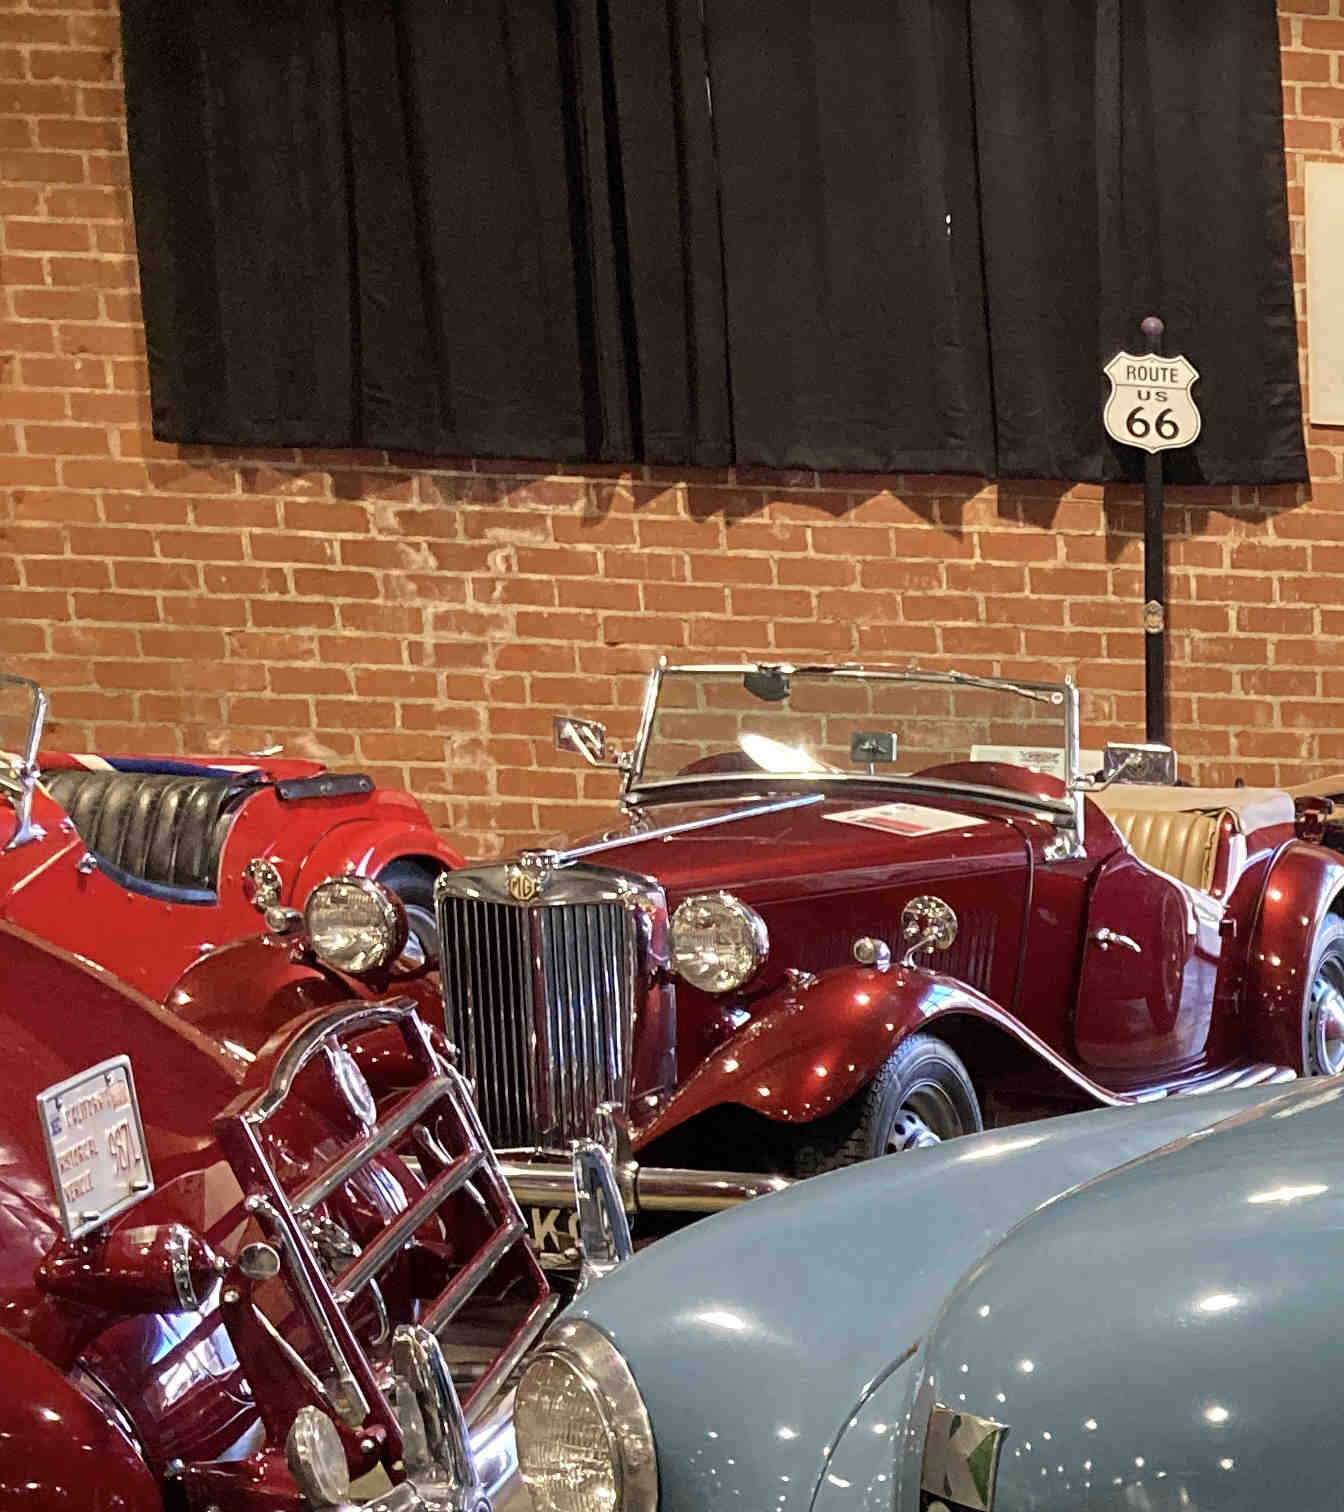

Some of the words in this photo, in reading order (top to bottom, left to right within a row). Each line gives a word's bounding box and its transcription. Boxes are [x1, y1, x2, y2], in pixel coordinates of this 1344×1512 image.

[1126, 365, 1179, 383] ROUTE
[1137, 389, 1168, 402] US
[1126, 406, 1180, 440] 66
[511, 875, 536, 900] MG
